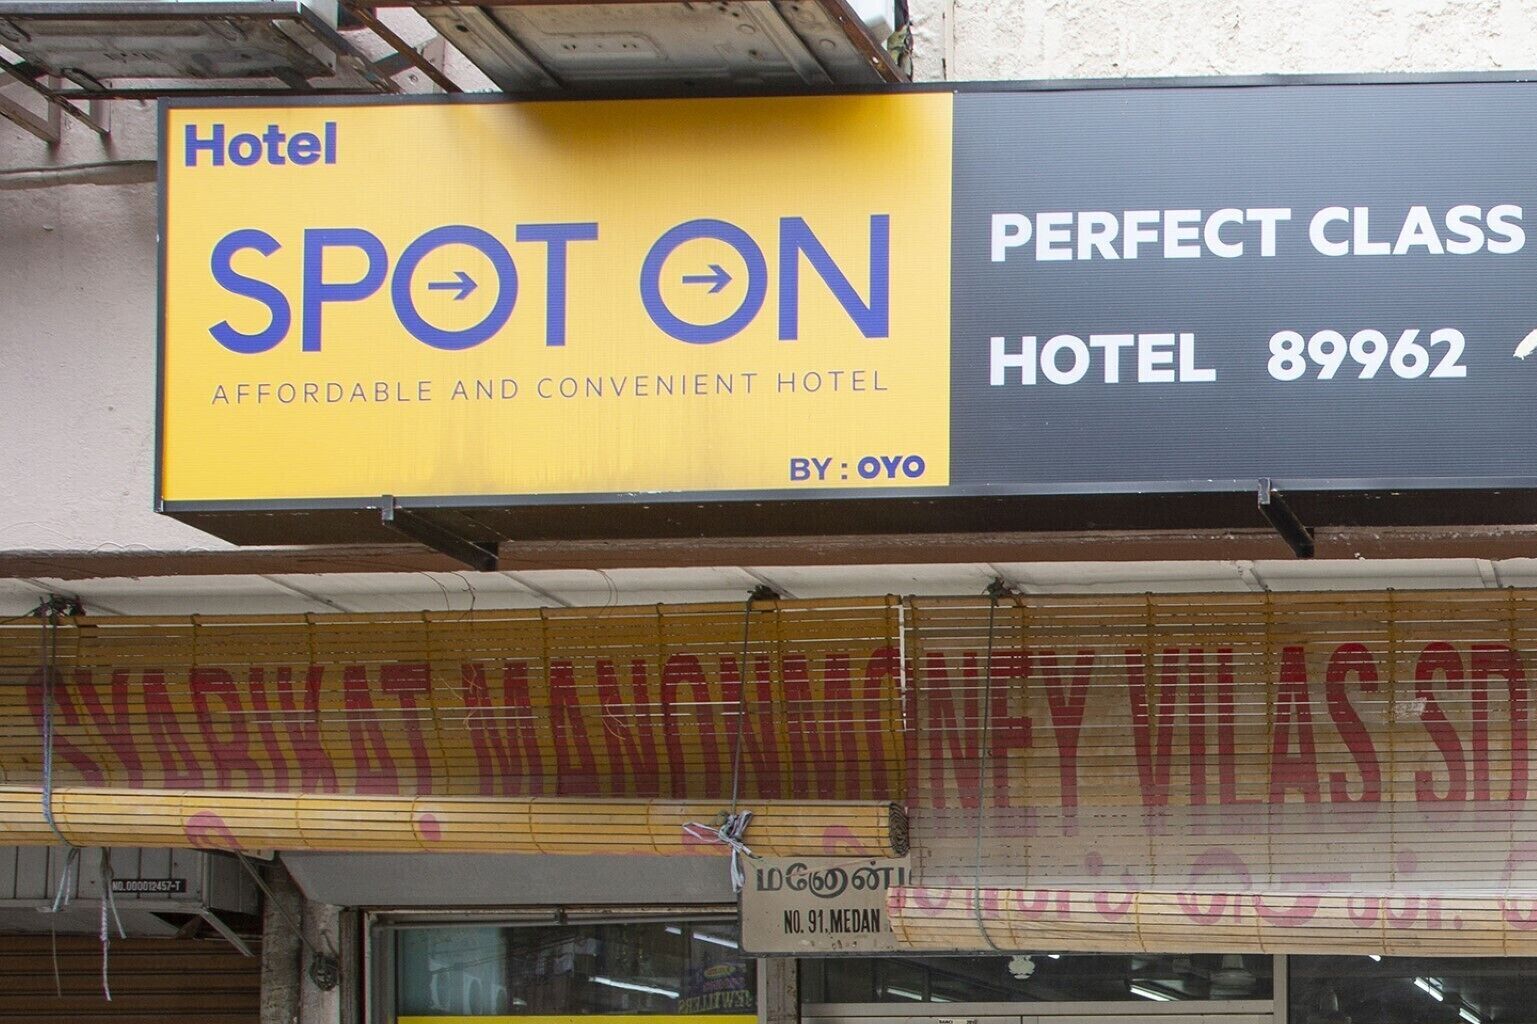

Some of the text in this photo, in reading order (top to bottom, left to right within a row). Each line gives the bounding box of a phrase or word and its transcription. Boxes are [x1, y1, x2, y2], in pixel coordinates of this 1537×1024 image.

[183, 121, 336, 167] Hotel
[991, 204, 1526, 262] PERFECT CLASS
[208, 213, 890, 354] SPOT ON
[990, 328, 1467, 386] HOTEL 89962
[211, 369, 889, 406] AFFORDABLE AND CONVENIENT HOTEL
[789, 457, 832, 482] BY
[857, 454, 925, 480] OYO
[1125, 643, 1381, 834] VILAS
[784, 910, 804, 934] NO.
